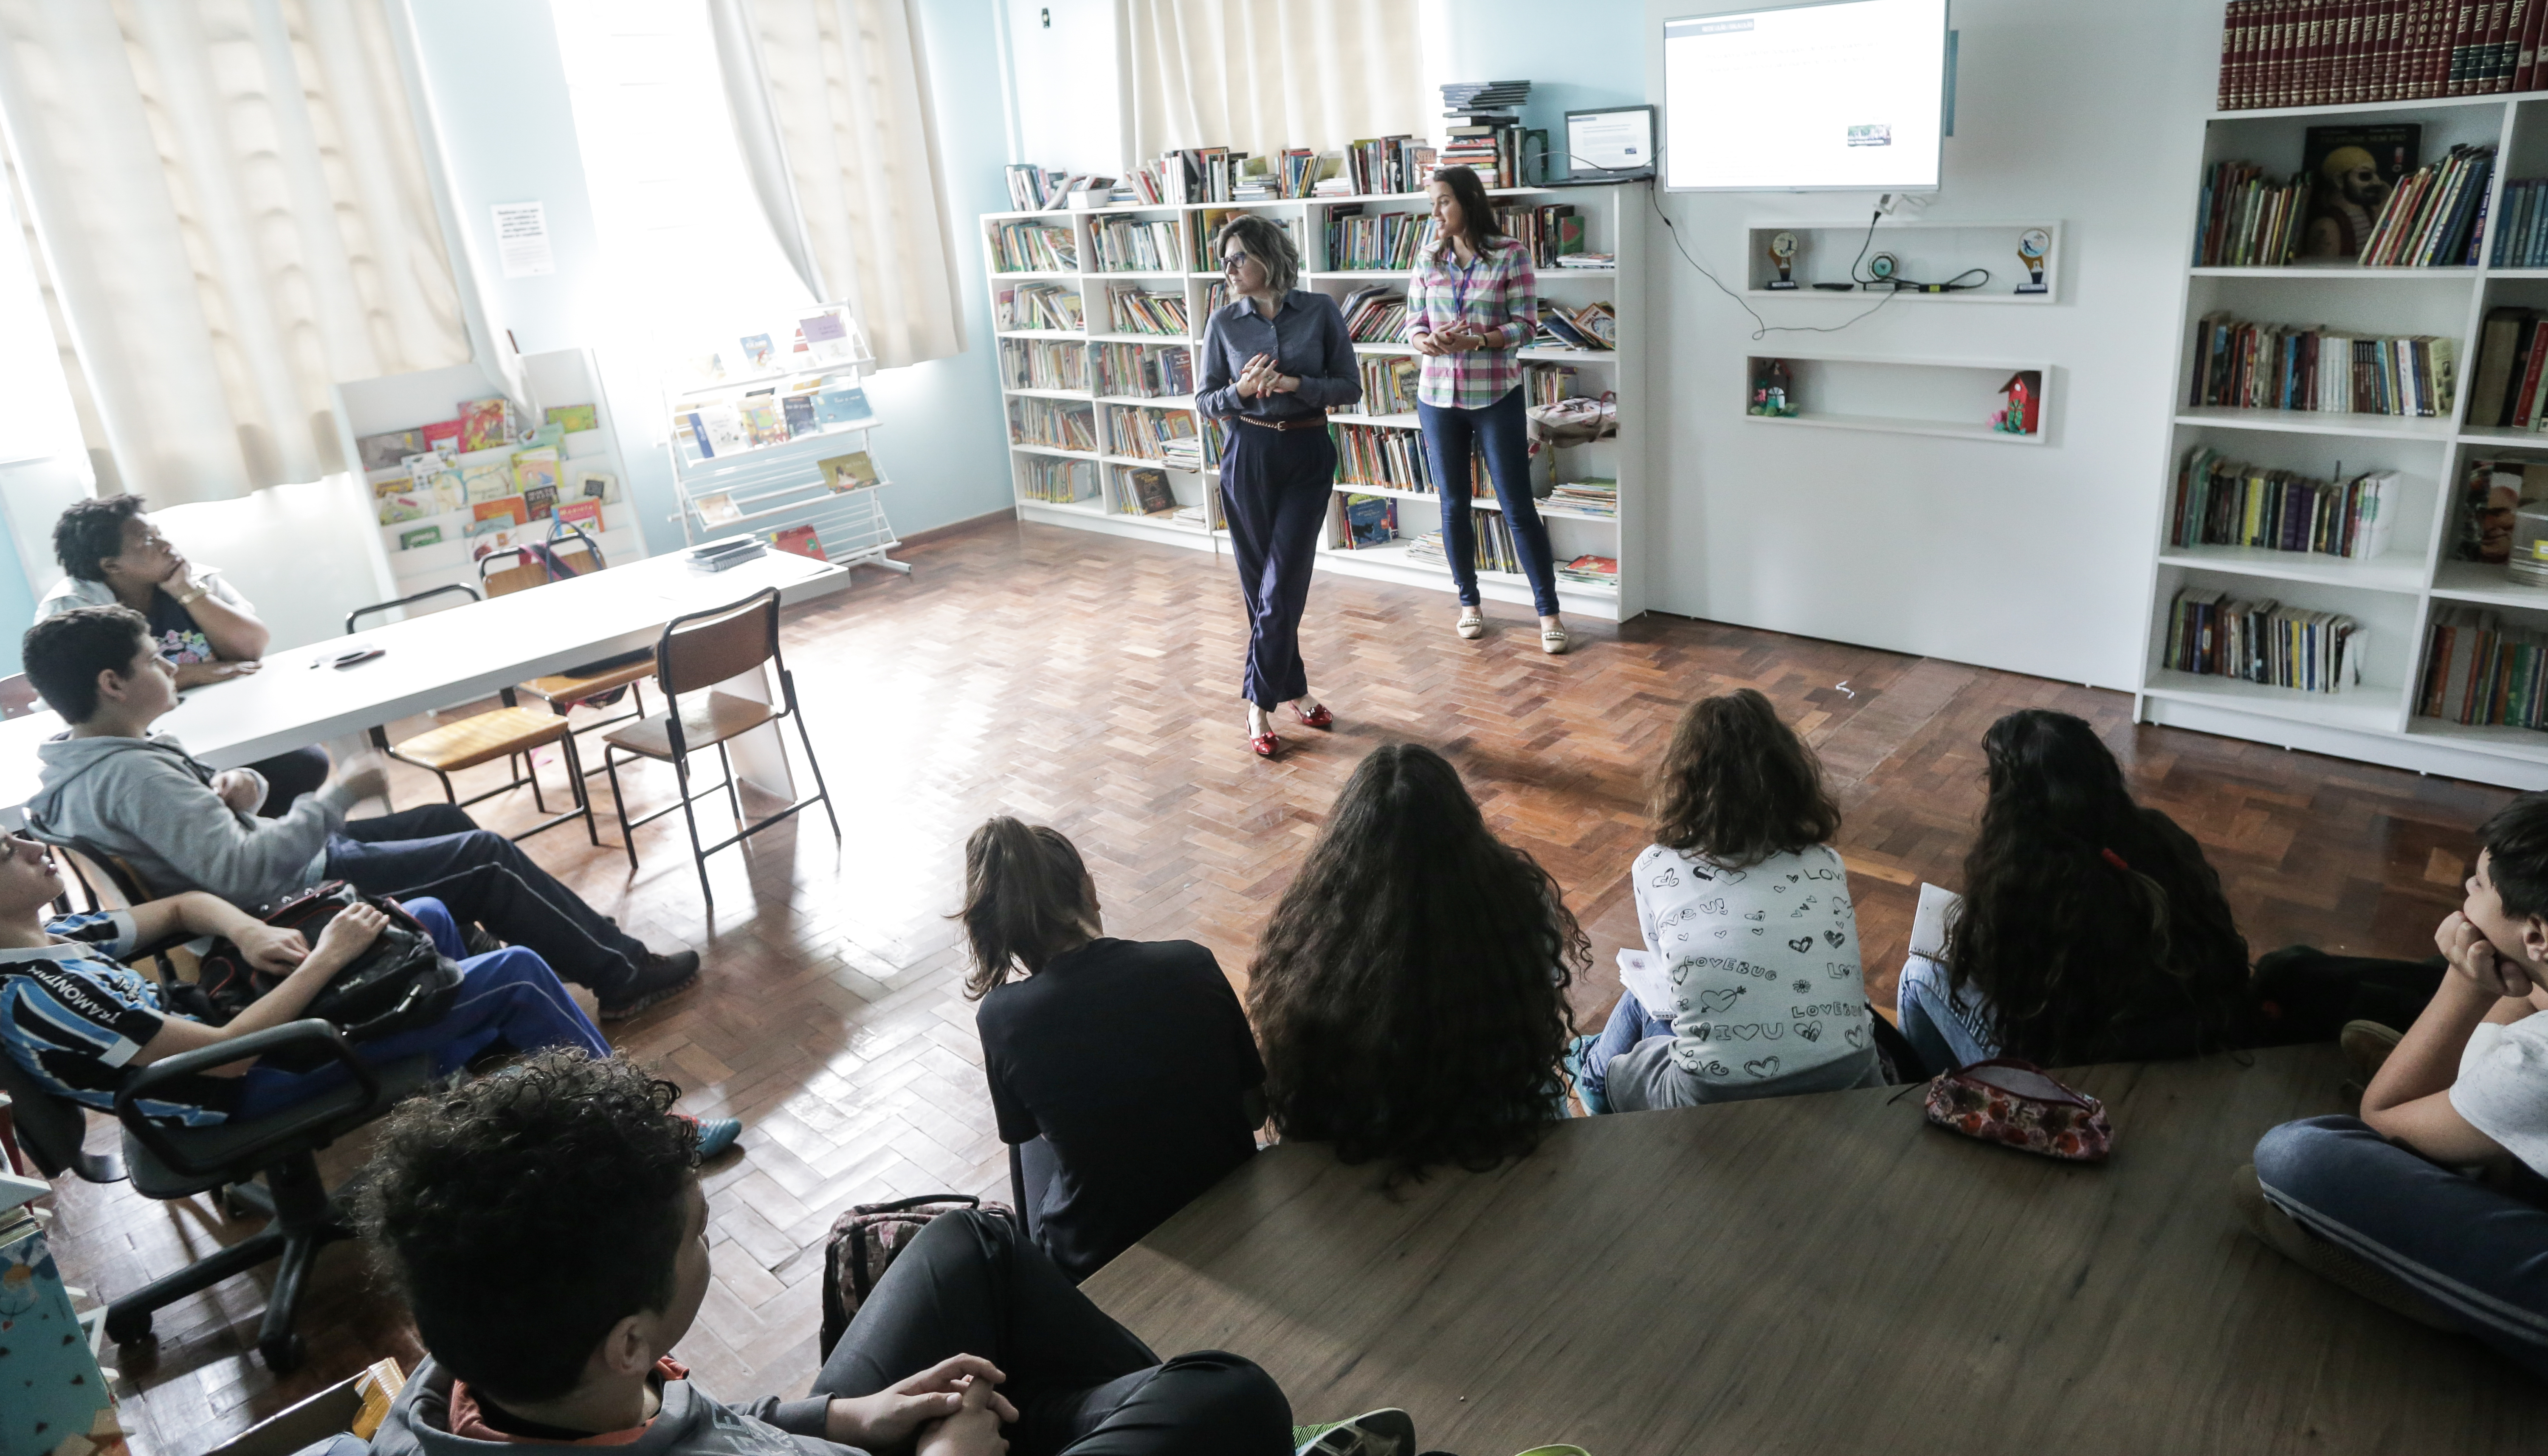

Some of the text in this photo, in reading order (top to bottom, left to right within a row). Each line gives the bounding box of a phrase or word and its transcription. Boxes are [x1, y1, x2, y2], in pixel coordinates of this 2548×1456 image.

[2405, 2, 2418, 46] 2000
[2418, 0, 2431, 45] 2001
[2430, 0, 2444, 44] 2002
[2457, 6, 2473, 34] Barsa
[2475, 4, 2490, 31] Barsa
[2509, 0, 2526, 28] Barsa
[1684, 955, 1777, 981] LOVEBUG
[1674, 1050, 1730, 1076] Love
